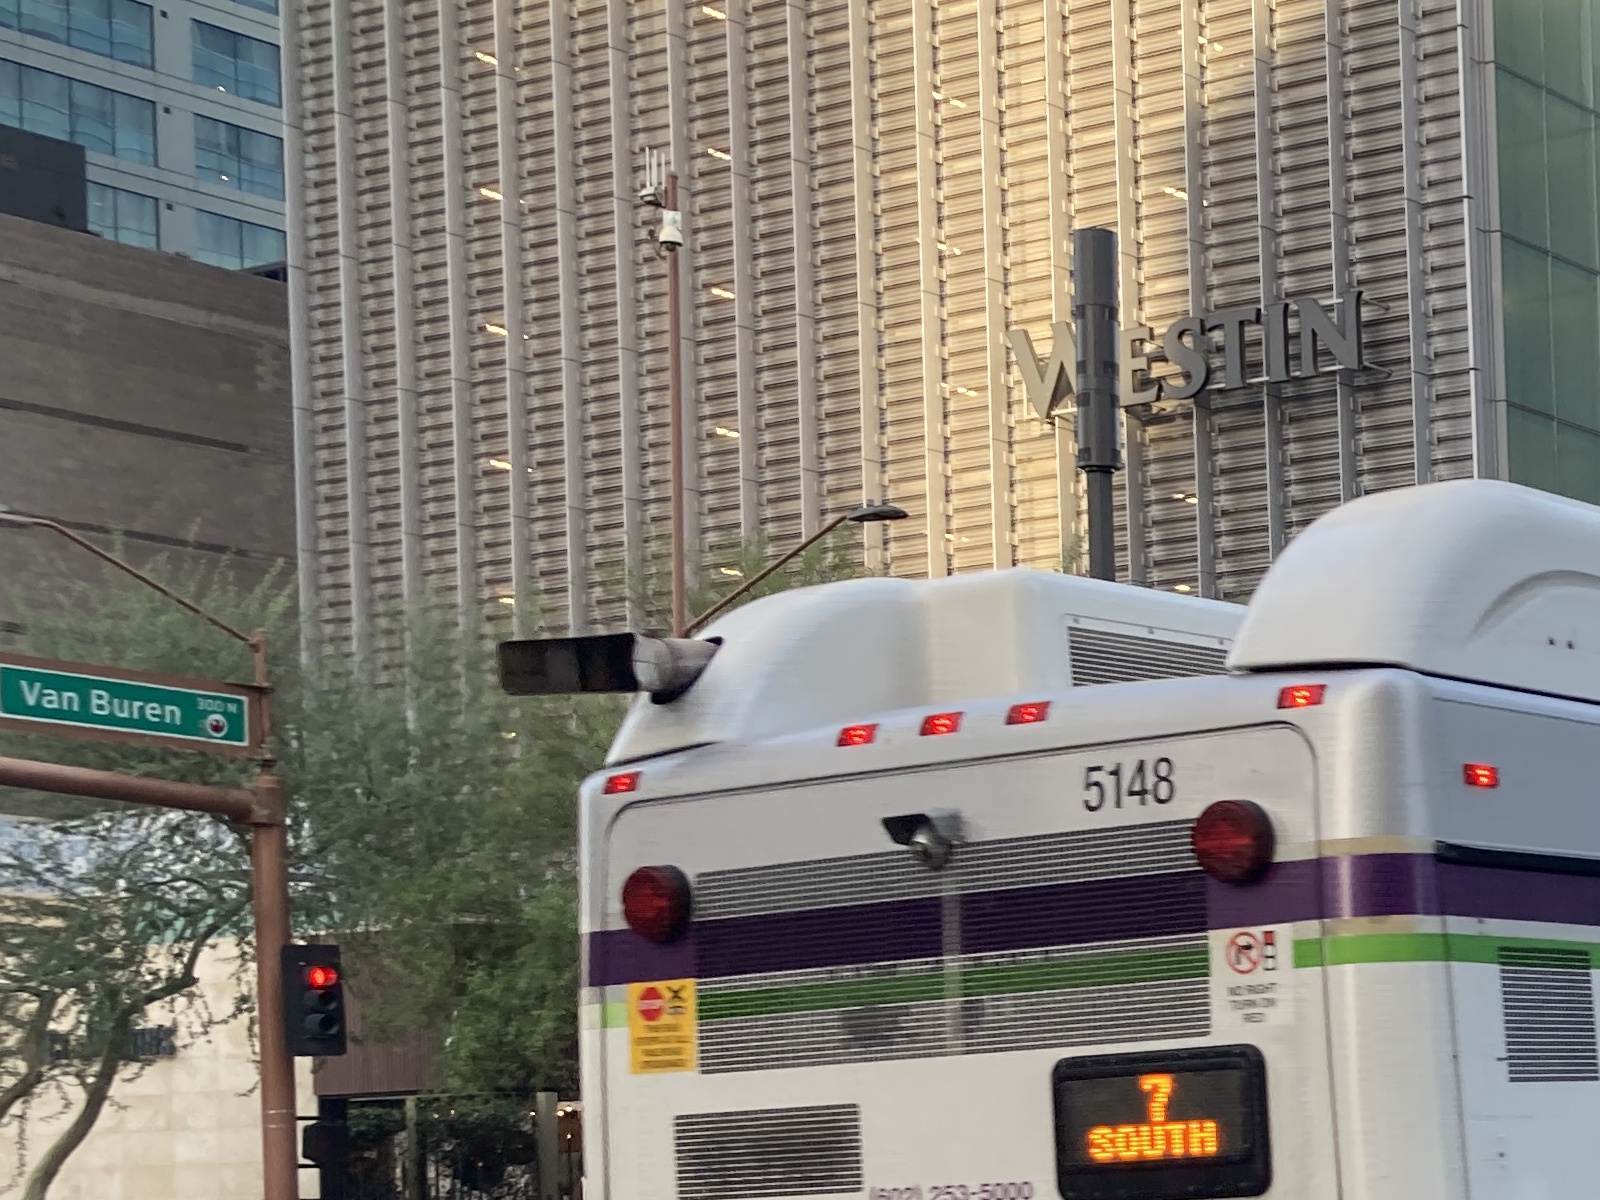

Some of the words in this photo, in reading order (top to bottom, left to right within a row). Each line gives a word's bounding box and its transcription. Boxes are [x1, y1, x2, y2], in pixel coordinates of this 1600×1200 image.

[1005, 290, 1364, 419] WESTIN
[19, 680, 79, 712] Van
[90, 689, 182, 726] Buren
[1083, 757, 1175, 811] 5148
[1138, 1073, 1174, 1123] 7
[1087, 1119, 1218, 1164] SOUTH
